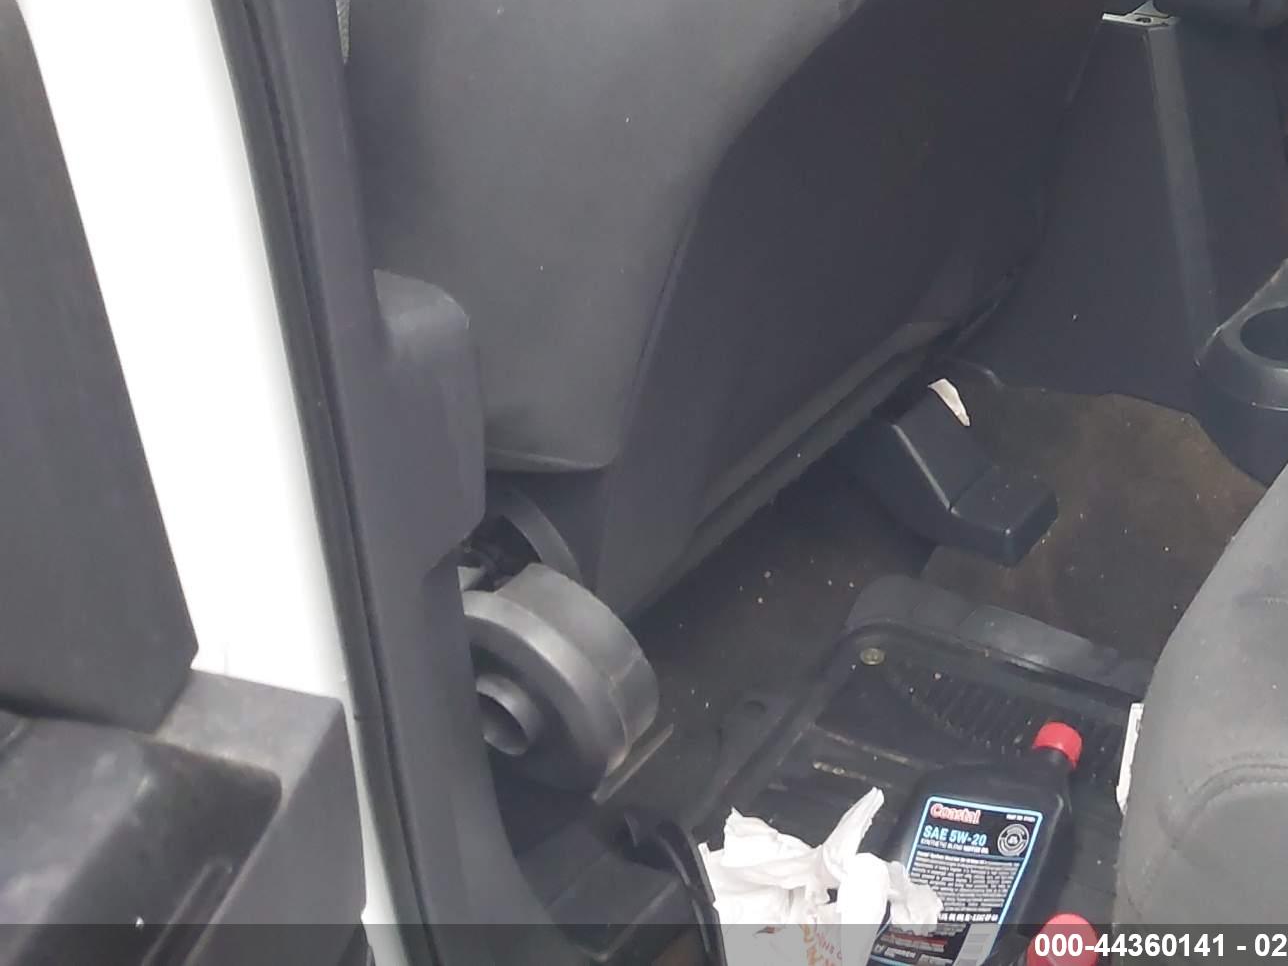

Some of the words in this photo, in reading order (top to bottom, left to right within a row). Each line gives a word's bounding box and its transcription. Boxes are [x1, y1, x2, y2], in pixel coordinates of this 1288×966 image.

[930, 803, 981, 825] Coastal
[922, 825, 949, 841] SAE
[948, 829, 988, 847] 5W-20
